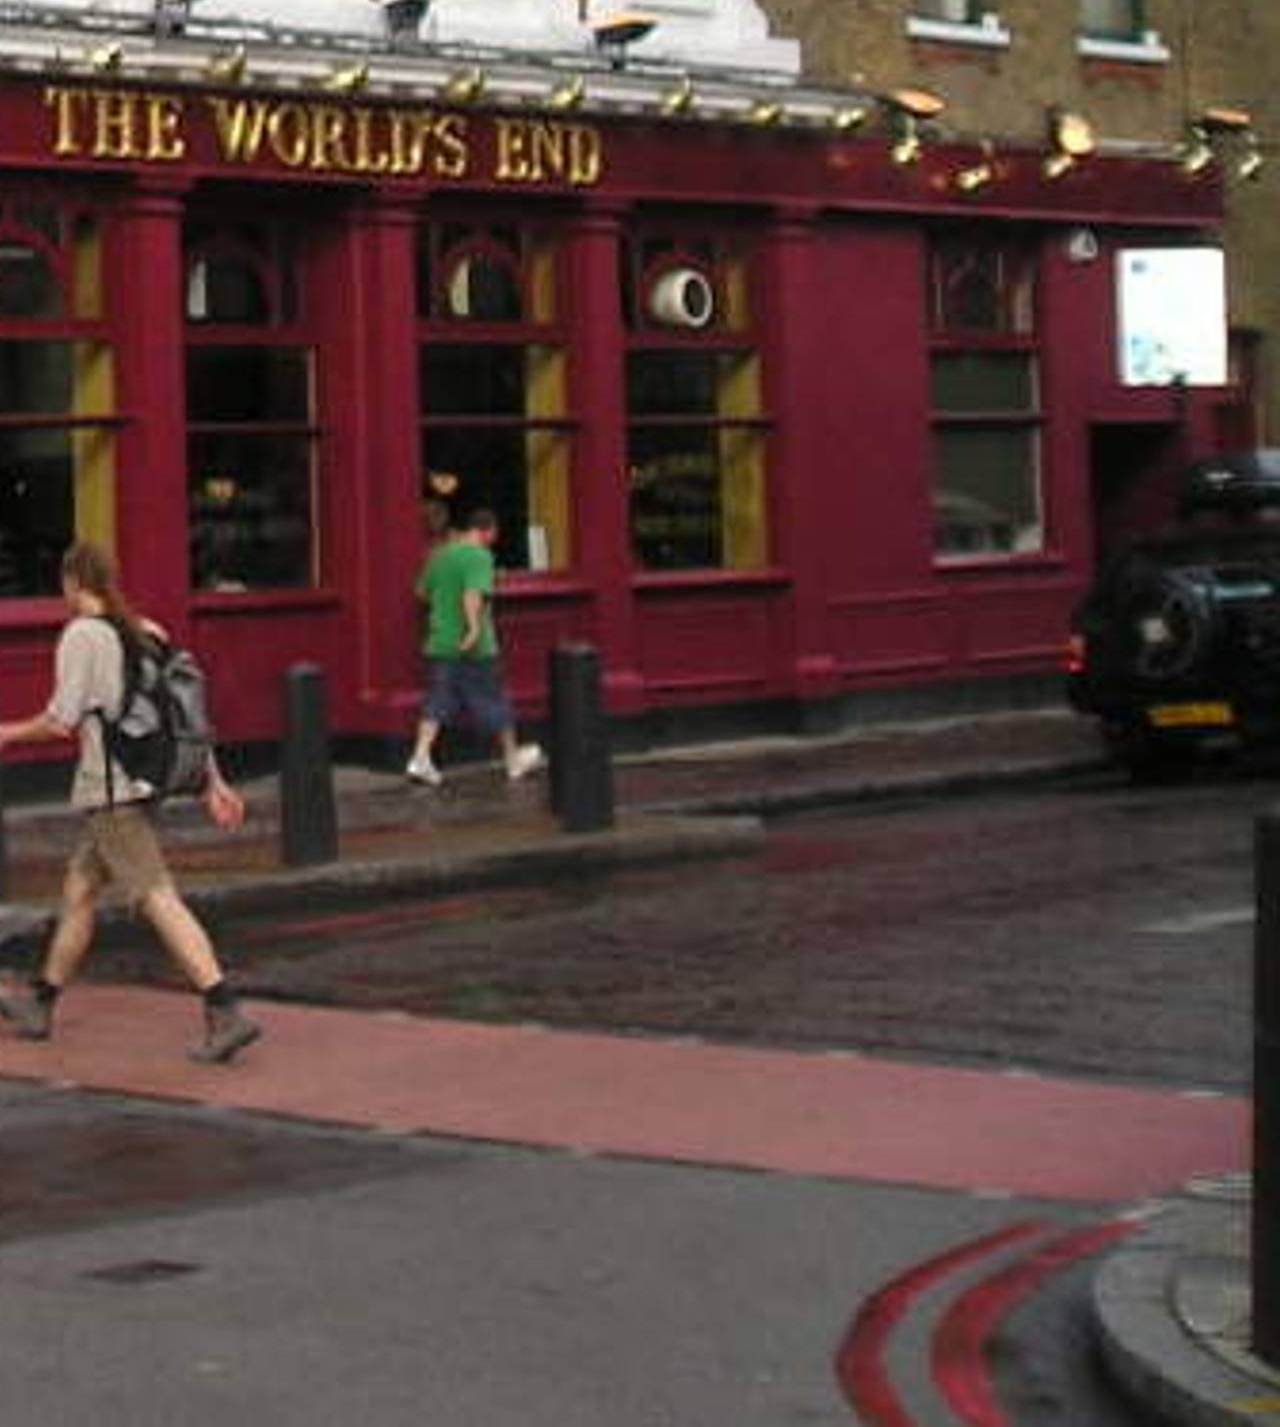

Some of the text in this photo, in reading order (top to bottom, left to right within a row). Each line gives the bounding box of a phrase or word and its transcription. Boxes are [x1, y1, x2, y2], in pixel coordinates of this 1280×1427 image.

[45, 86, 603, 186] THE WORLD'S END
